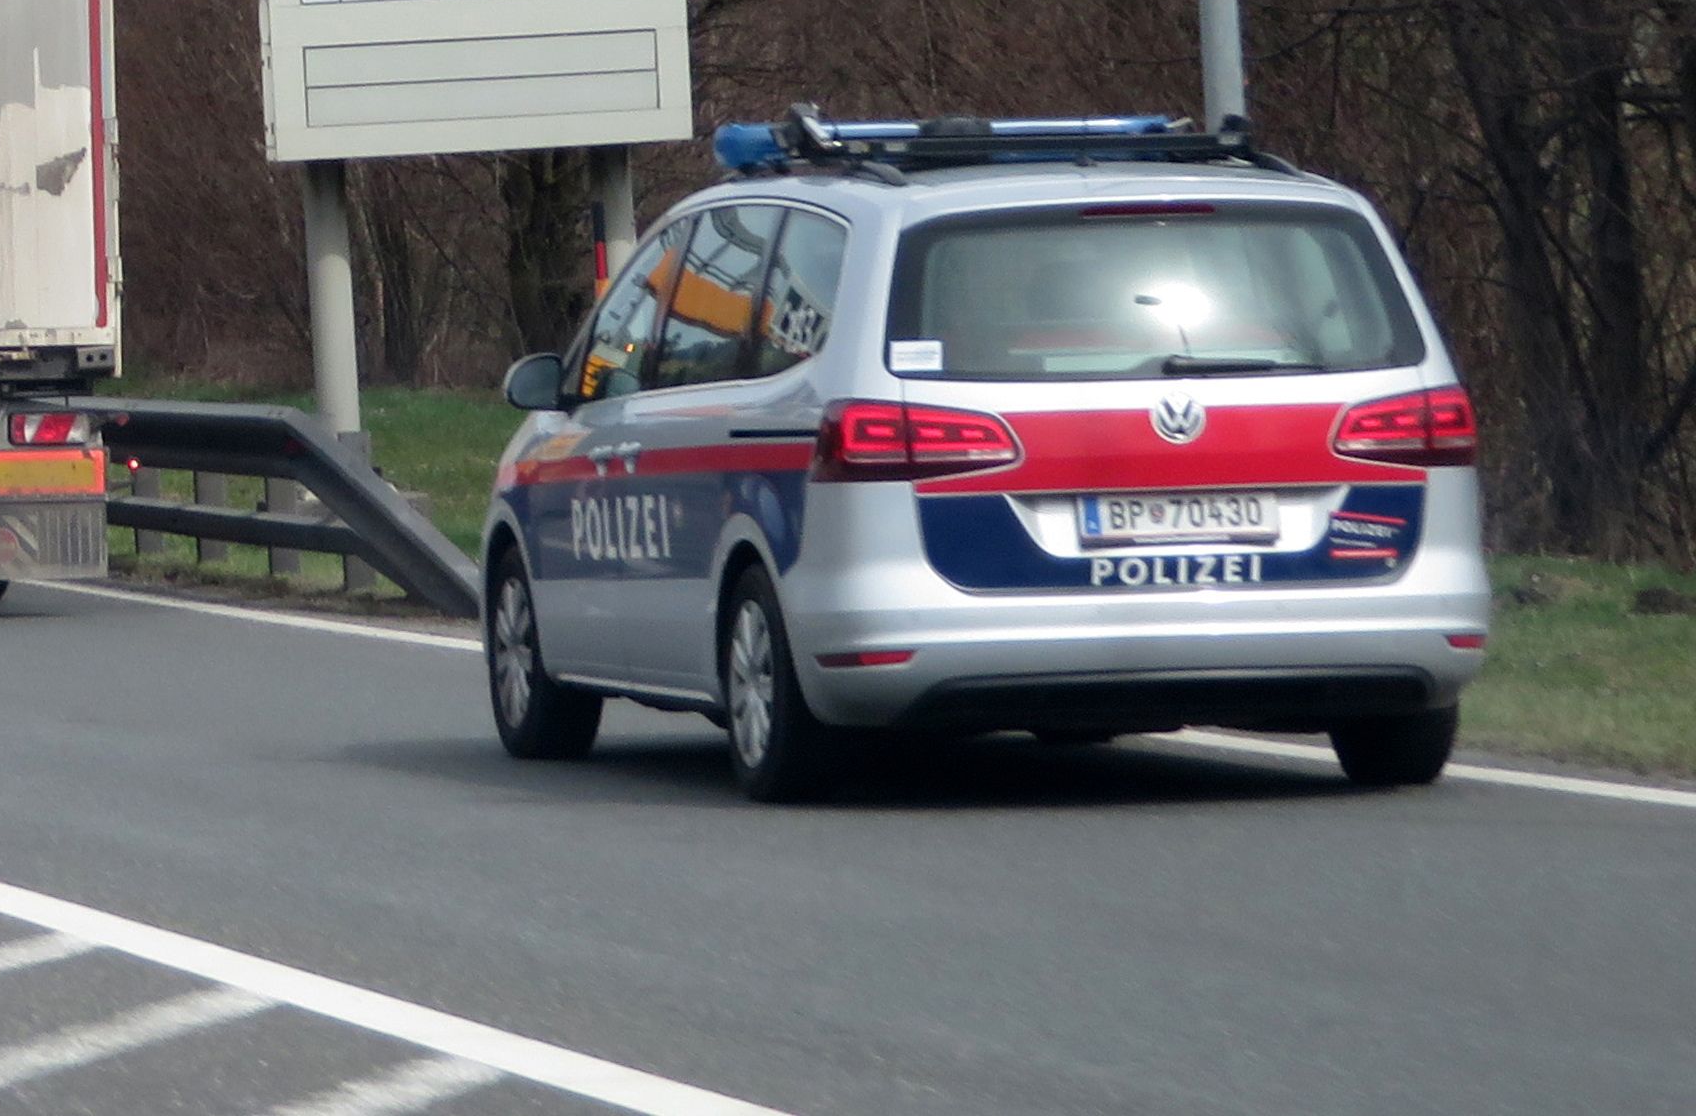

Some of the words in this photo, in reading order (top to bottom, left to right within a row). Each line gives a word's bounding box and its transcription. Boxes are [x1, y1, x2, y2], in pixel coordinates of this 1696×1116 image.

[570, 493, 672, 561] POLIZEI
[1108, 500, 1144, 530] BP
[1168, 495, 1263, 529] 70430
[1091, 554, 1263, 586] POLIZEI
